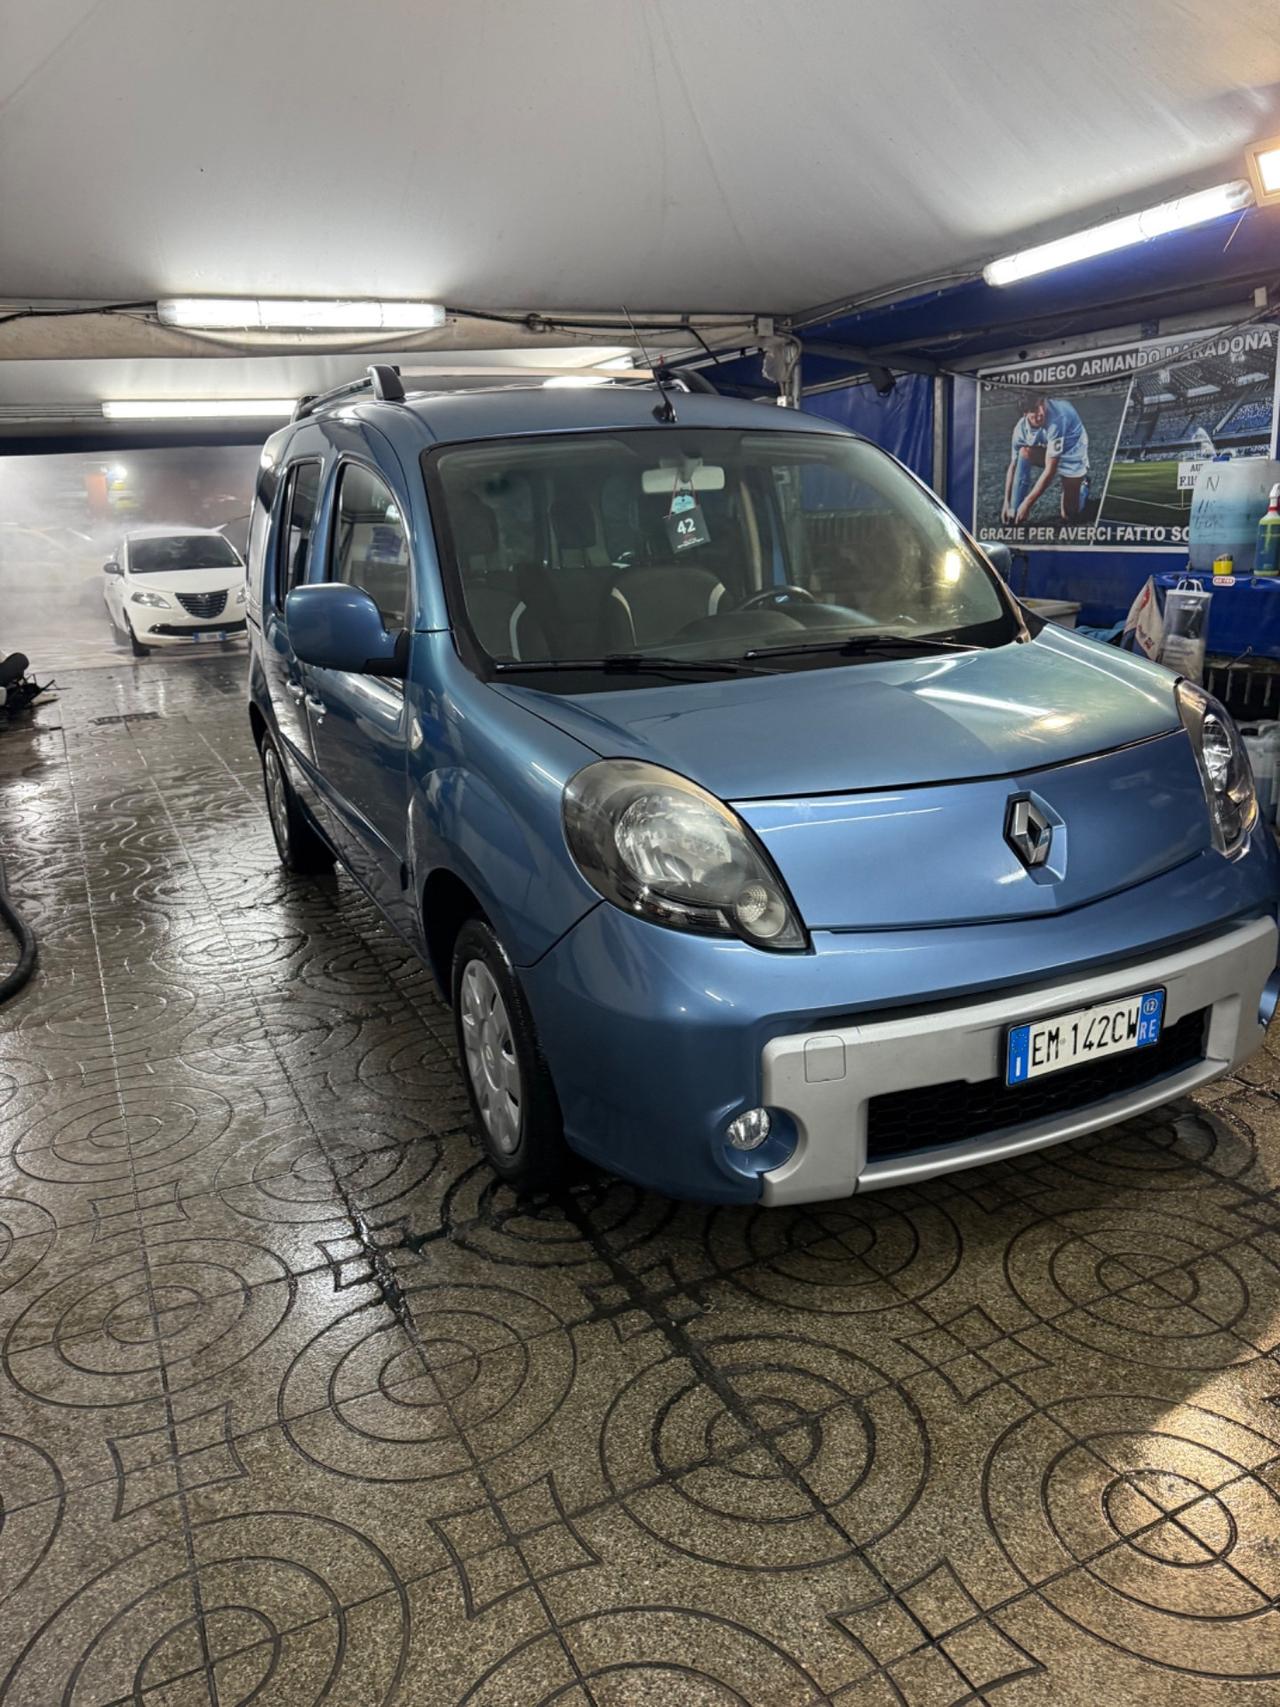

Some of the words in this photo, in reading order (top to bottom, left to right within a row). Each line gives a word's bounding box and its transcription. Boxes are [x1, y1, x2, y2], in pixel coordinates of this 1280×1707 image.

[1033, 363, 1077, 383] DIEGO
[1080, 350, 1160, 376] ARMANDO
[677, 518, 696, 535] 42
[980, 527, 1025, 541] GRAZIE
[1029, 527, 1054, 540] PER
[1058, 526, 1111, 541] AVERCI
[1116, 526, 1166, 541] FATTO
[1032, 1026, 1060, 1067] EM
[1071, 1006, 1140, 1055] 142CW
[1140, 1019, 1157, 1040] RE
